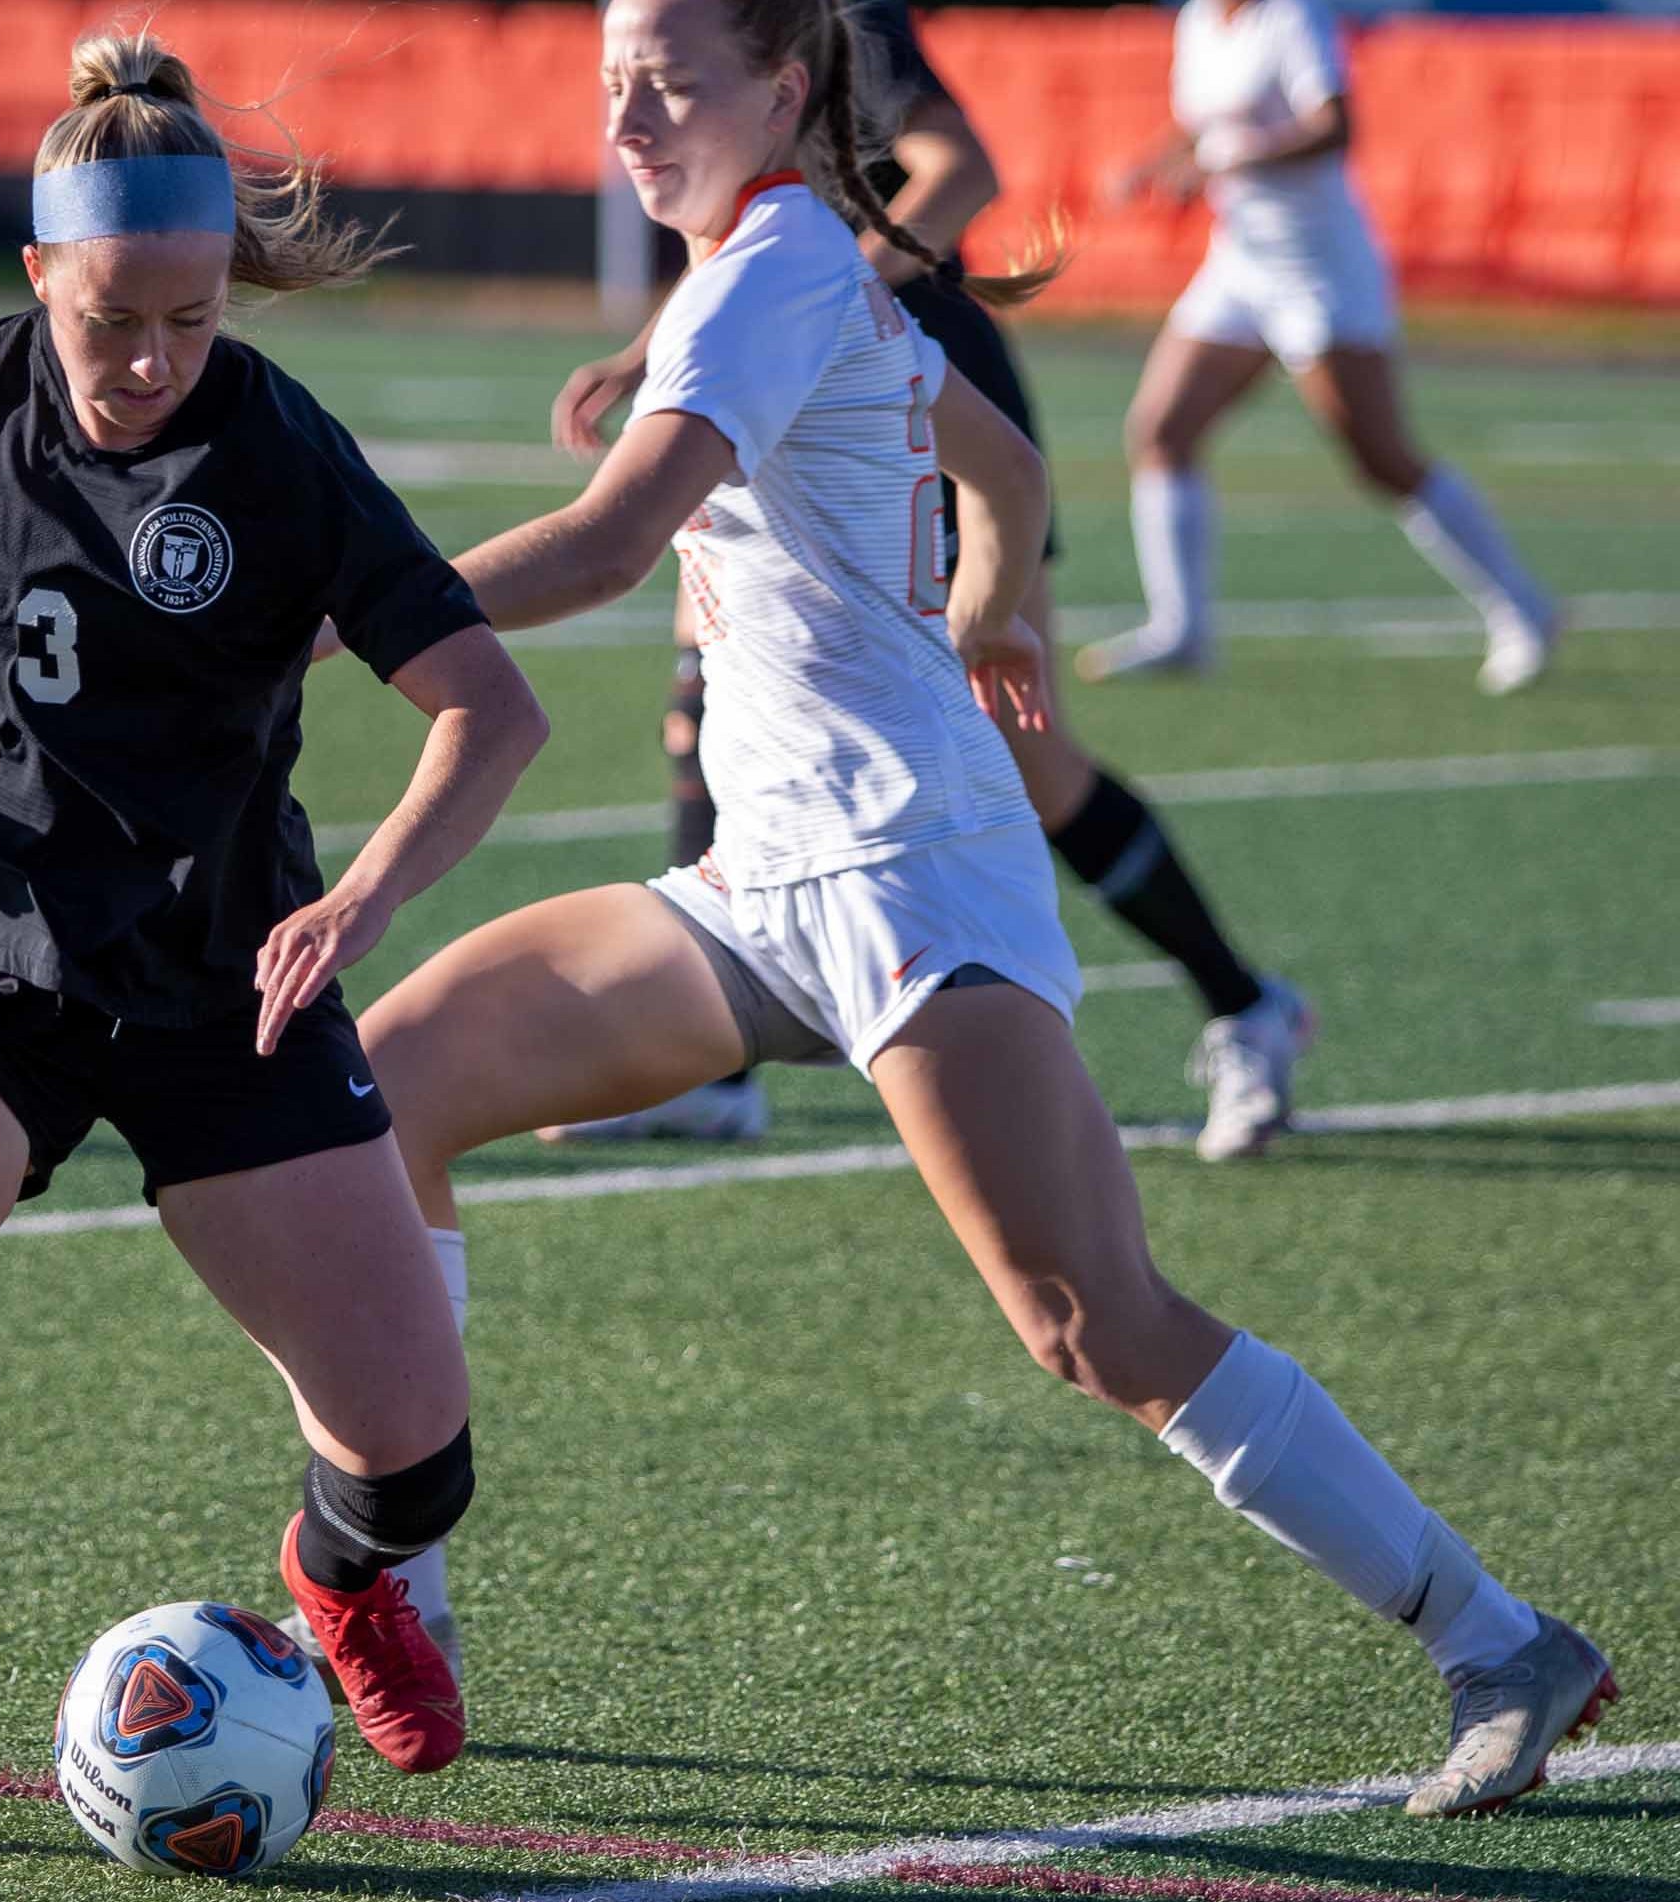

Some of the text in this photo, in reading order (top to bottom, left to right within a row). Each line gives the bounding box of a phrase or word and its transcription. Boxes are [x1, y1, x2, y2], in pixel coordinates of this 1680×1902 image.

[137, 512, 224, 591] RENSSELAER POLYTECHNIC INSTITUTE
[17, 588, 81, 704] 3
[67, 1778, 116, 1839] NCAA
[71, 1739, 134, 1815] Wilson
